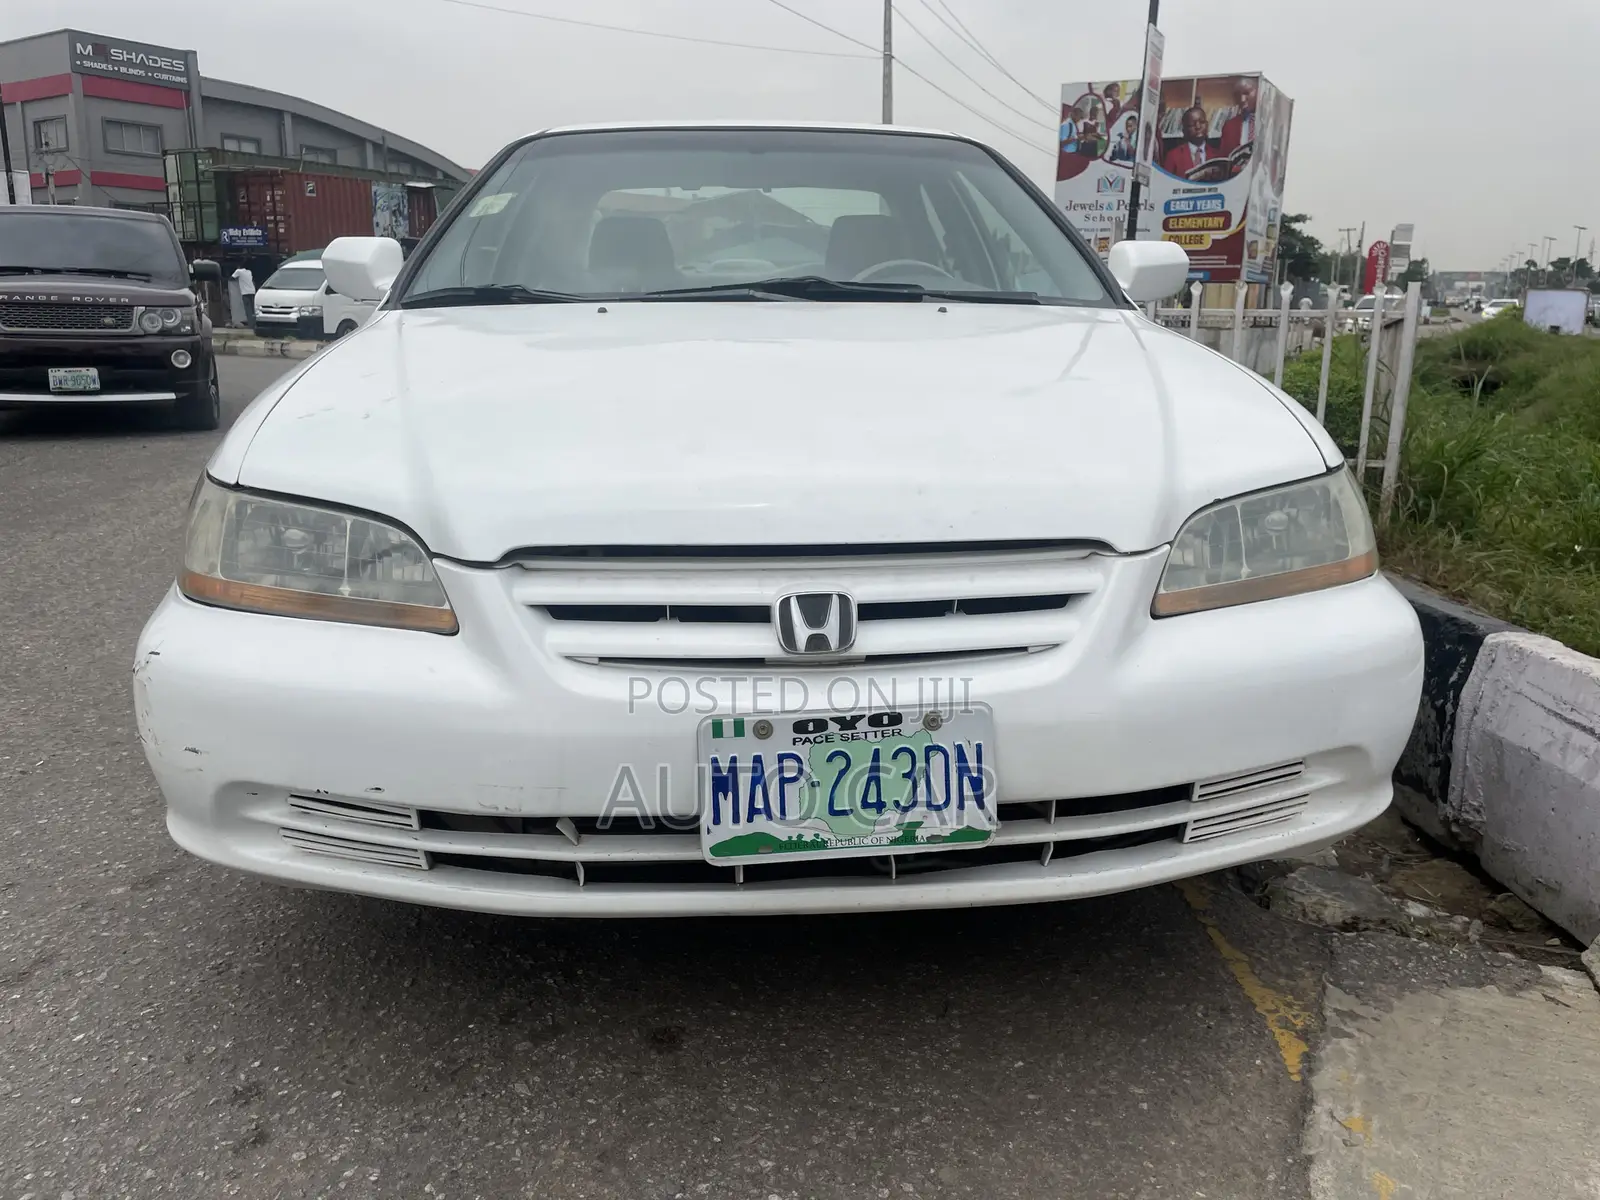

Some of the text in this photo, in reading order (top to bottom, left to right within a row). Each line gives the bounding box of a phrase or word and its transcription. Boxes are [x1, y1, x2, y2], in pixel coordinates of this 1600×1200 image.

[110, 48, 185, 72] SHADES
[83, 60, 188, 83] SHADES BLINDS CURTAINS
[1065, 199, 1155, 211] Jewels & Perls
[1170, 199, 1222, 211] EARLY YEARS
[1084, 213, 1126, 222] School
[1169, 217, 1225, 229] ELEMENTARY
[1168, 234, 1205, 245] COLLEGE
[792, 712, 903, 735] OYO
[792, 728, 902, 747] PACE SETTER
[779, 834, 927, 851] FEDERAL REPUBLIC OF NIGERIA
